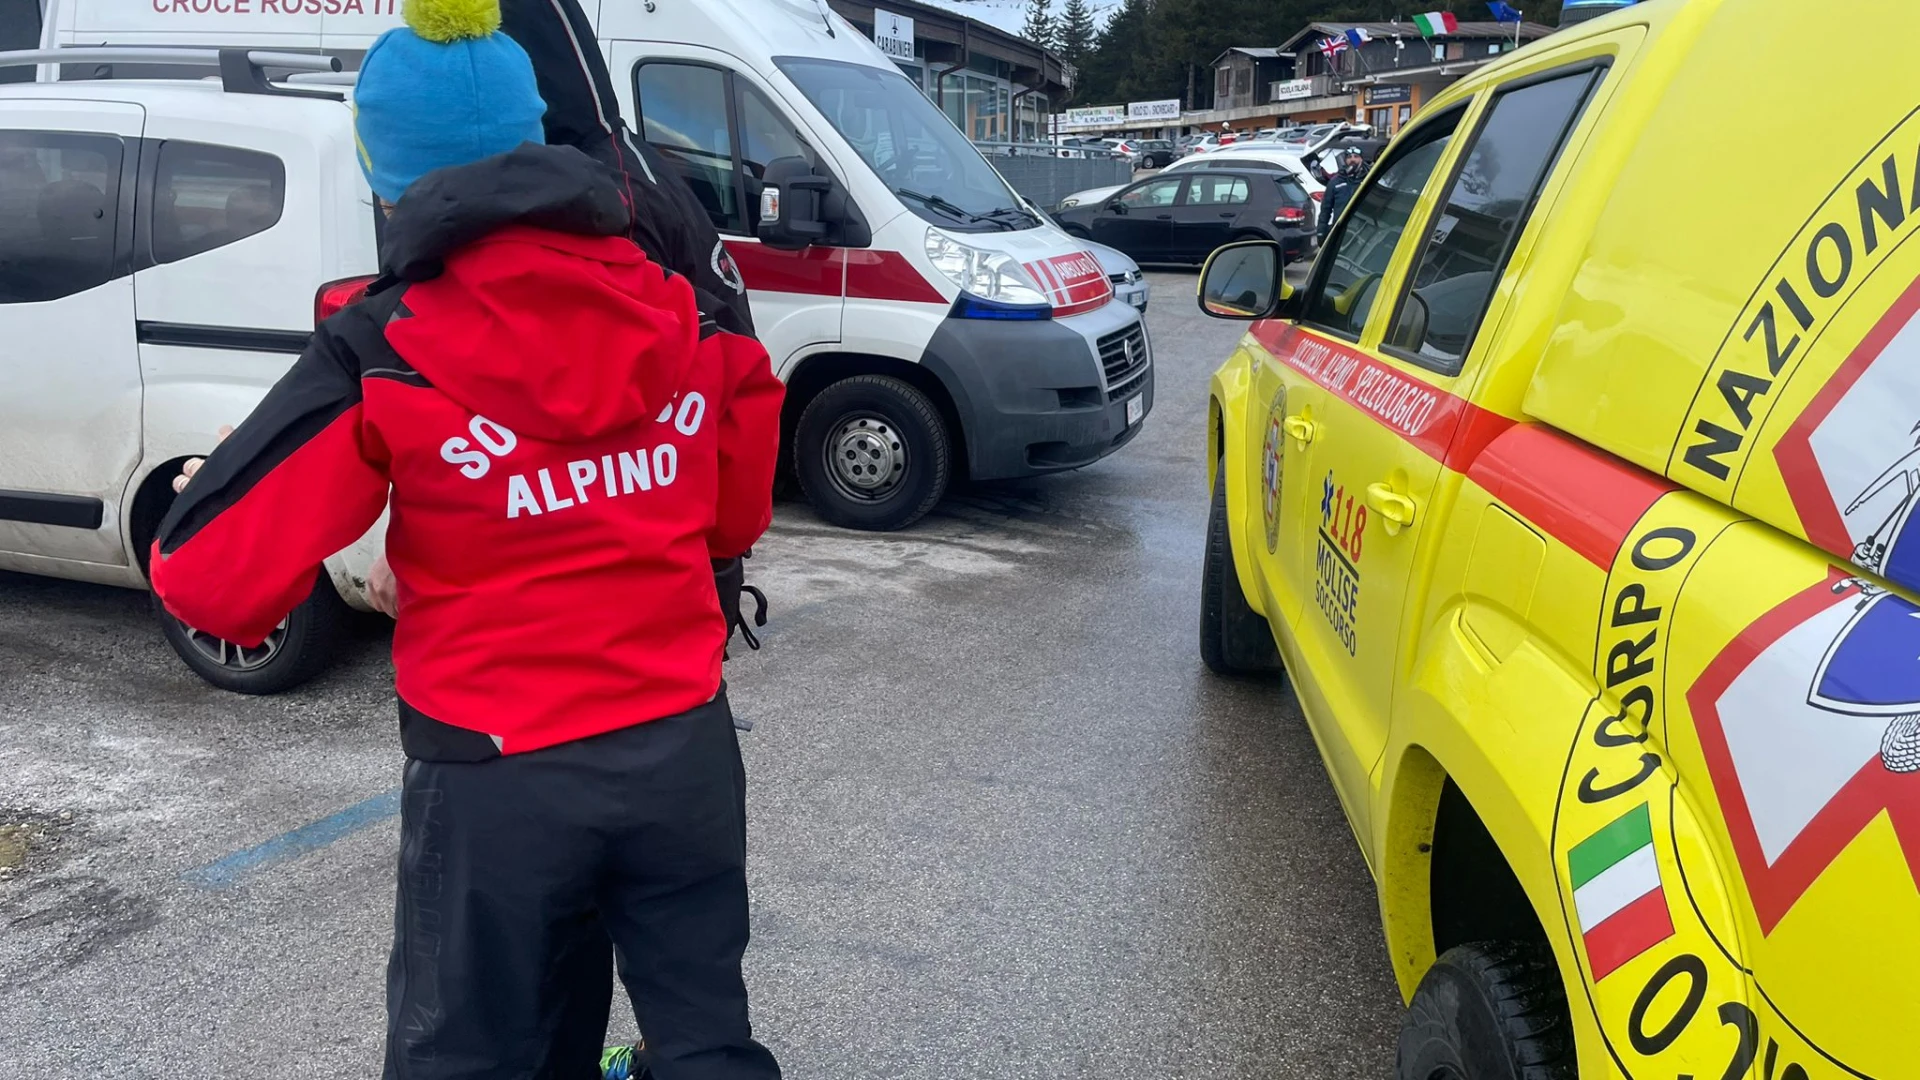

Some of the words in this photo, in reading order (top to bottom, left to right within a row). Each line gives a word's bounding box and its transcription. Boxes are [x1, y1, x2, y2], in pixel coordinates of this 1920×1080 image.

[877, 35, 913, 58] CARABINIERI
[1290, 338, 1331, 375] SOCCORSO
[1319, 352, 1360, 391] ALPINO
[1348, 365, 1436, 436] SPELEOLOGICO
[507, 443, 677, 518] ALPINO
[1331, 485, 1367, 563] 118
[1315, 579, 1356, 658] SOCCORSO
[1316, 539, 1359, 624] MOLISE
[1578, 527, 1696, 803] CORPO
